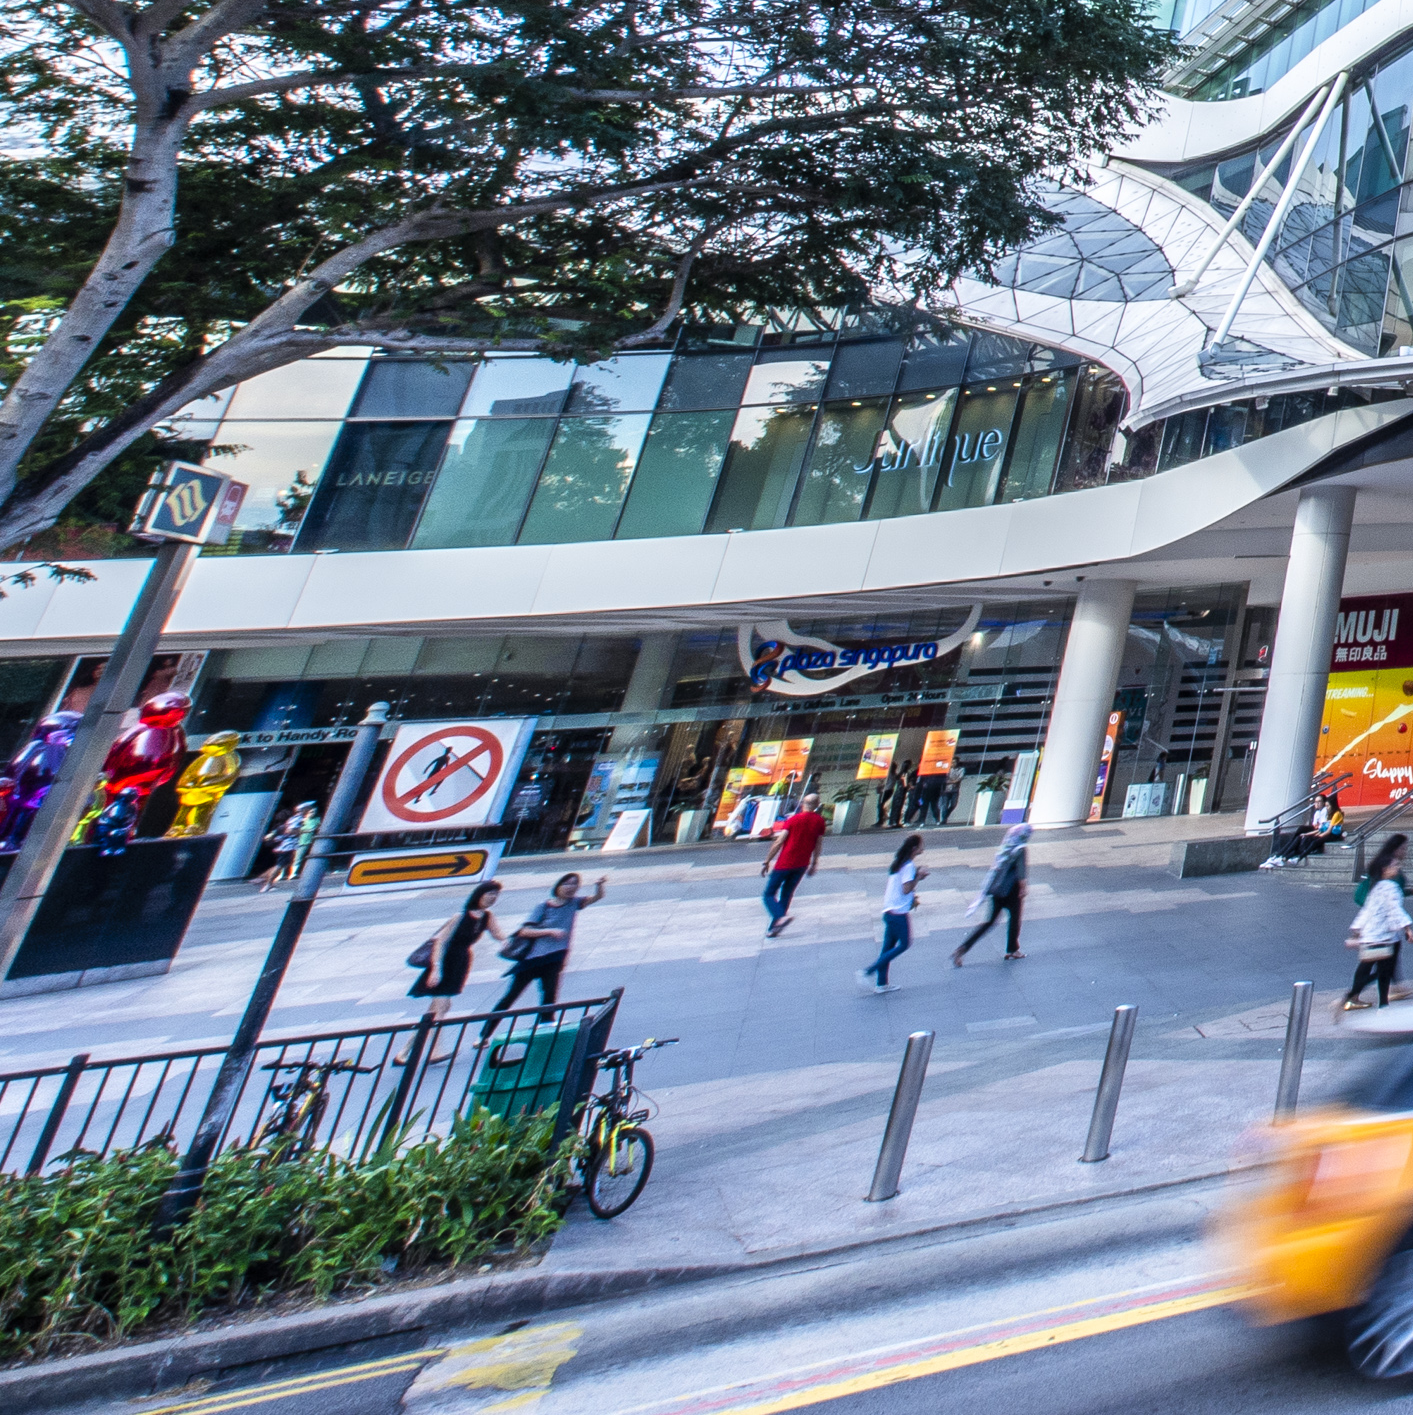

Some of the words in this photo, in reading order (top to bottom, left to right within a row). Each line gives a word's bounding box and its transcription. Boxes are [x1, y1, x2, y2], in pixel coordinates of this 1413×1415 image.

[336, 470, 435, 486] LANEIGE
[1334, 608, 1400, 644] MUJI
[778, 649, 835, 676] plaza
[838, 642, 939, 670] singapura
[1334, 646, 1387, 663] 無印良品
[840, 697, 861, 707] Lane
[881, 693, 903, 704] Open
[922, 690, 947, 701] Hours
[258, 732, 273, 743] to
[277, 730, 331, 743] Handy
[1363, 757, 1413, 784] Slappy
